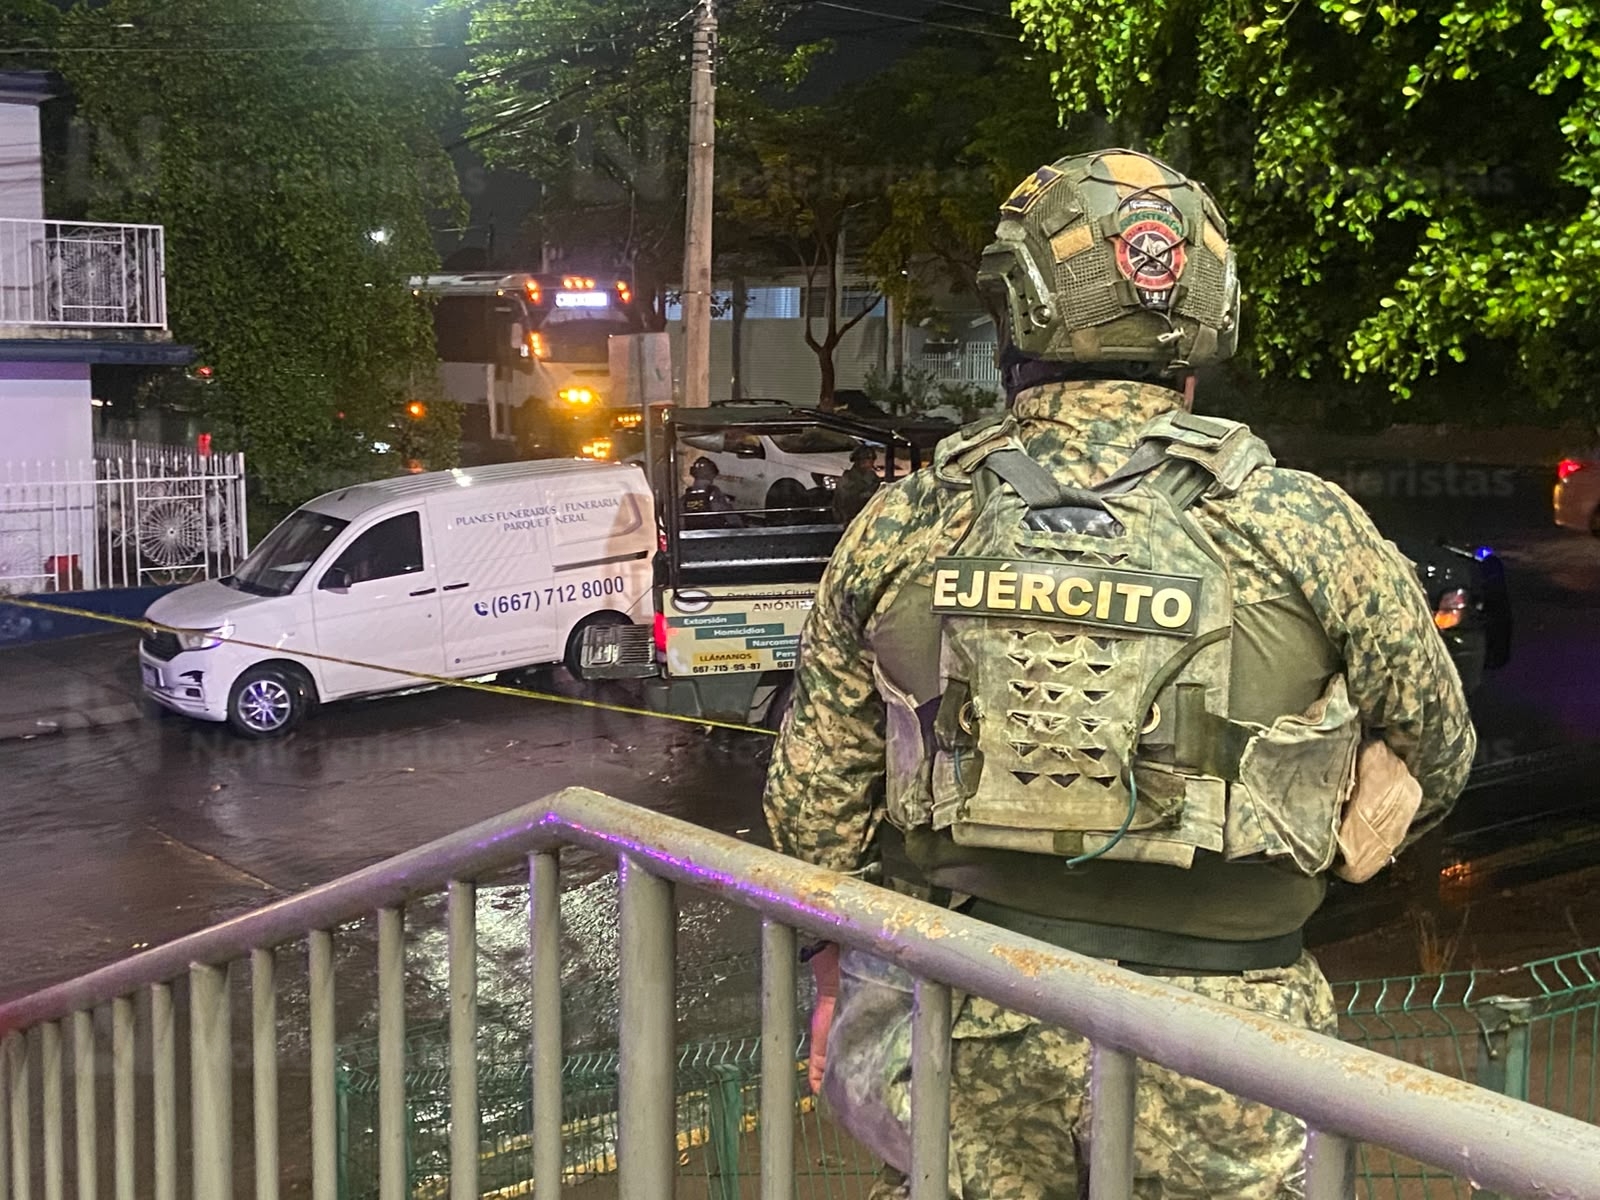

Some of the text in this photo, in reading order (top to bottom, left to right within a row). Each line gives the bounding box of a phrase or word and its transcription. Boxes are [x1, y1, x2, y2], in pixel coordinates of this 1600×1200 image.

[456, 513, 495, 526] PLANES
[565, 498, 619, 512] FUNERARIA
[503, 513, 587, 532] PARQUE FNERAL
[491, 576, 624, 619] (667) 712 8000
[933, 562, 1193, 629] EJÉRCITO
[683, 616, 728, 626] Extorsión
[713, 627, 766, 637] Homicidios
[752, 638, 800, 647] Narcomen
[699, 653, 752, 662] LLÁMANOS
